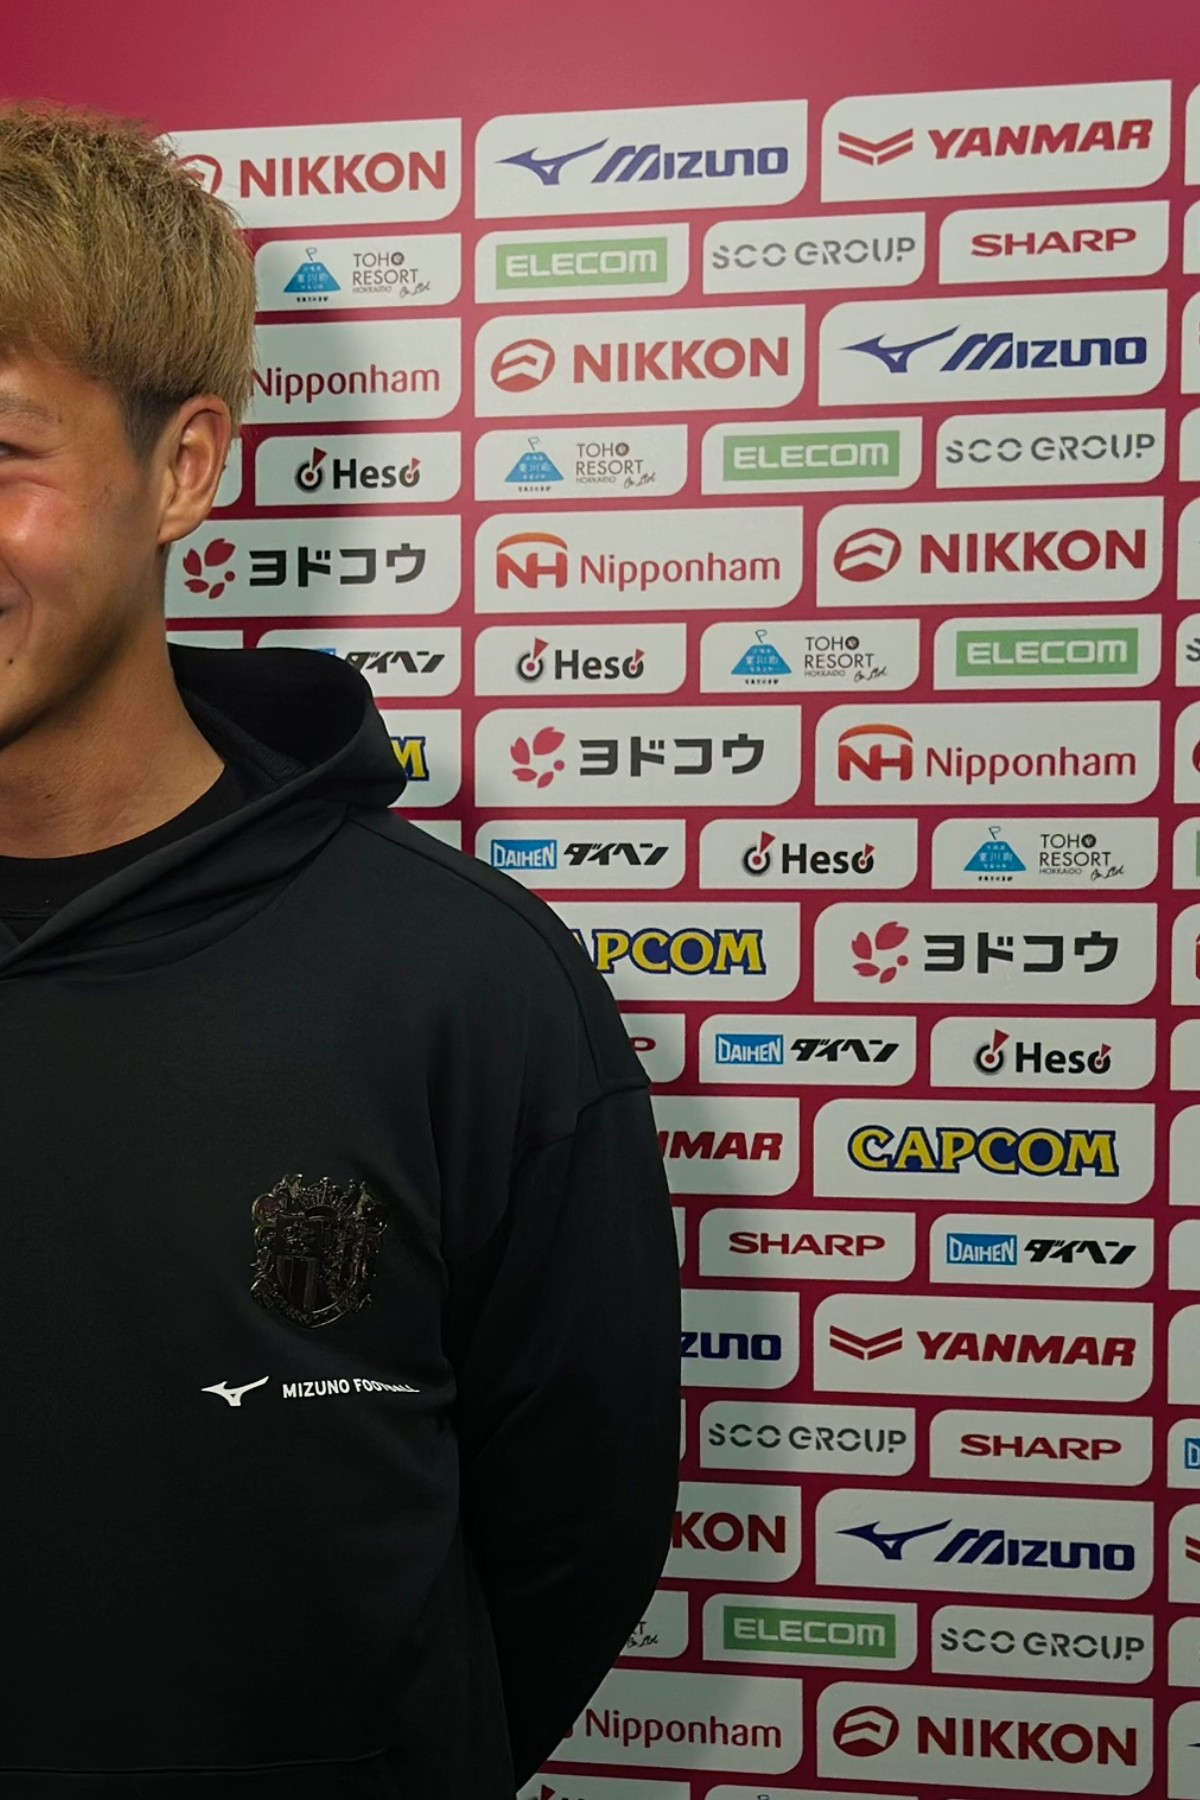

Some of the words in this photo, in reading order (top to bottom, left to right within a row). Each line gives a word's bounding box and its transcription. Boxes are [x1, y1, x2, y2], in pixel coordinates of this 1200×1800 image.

[928, 119, 1153, 160] YANMAR
[240, 150, 446, 198] NIKKON
[591, 144, 788, 184] MIZUNO
[712, 243, 786, 269] SCO
[795, 237, 916, 266] GROUP
[971, 228, 1137, 257] SHARP
[353, 251, 405, 268] TOHO
[506, 249, 657, 278] ELECOM
[353, 268, 418, 286] RESORT
[574, 337, 788, 383] NIKKON
[939, 332, 1147, 372] MIZUNO
[251, 364, 440, 404] Nipponham
[576, 442, 630, 458] TOHO
[733, 442, 889, 470] ELECOM
[946, 437, 1023, 464] SCO
[1031, 433, 1155, 461] GROUP
[333, 457, 420, 490] Heso
[575, 459, 644, 475] RESORT
[249, 543, 426, 588] ヨドコウ
[920, 529, 1146, 574] NIKKON
[581, 552, 780, 592] Nipponham
[805, 635, 860, 651] TOHO
[967, 639, 1128, 665] ELECOM
[555, 649, 645, 680] Heso
[804, 653, 875, 669] RESORT
[579, 733, 764, 777] ヨドコウ
[926, 746, 1136, 785] Nipponham
[493, 842, 555, 867] DAIHEN
[563, 842, 669, 866] ダイヘン
[1040, 833, 1097, 849] TOHO
[782, 843, 875, 875] Heso
[1039, 851, 1111, 867] RESORT
[570, 928, 766, 975] PCOM
[923, 931, 1118, 974] ヨドコウ
[718, 1037, 781, 1062] DAIHEN
[790, 1038, 899, 1062] ダイヘン
[1015, 1042, 1112, 1074] Heso
[847, 1125, 1119, 1177] CAPCOM
[729, 1232, 885, 1257] SHARP
[949, 1236, 1014, 1262] DAIHEN
[1024, 1239, 1137, 1265] ダイヘン
[916, 1331, 1136, 1367] YANMAR
[282, 1378, 351, 1398] MIZUNO
[708, 1423, 781, 1448] SCO
[788, 1426, 907, 1454] GROUP
[960, 1434, 1122, 1461] SHARP
[672, 1511, 786, 1553] KON
[933, 1528, 1135, 1571] MIZUNO
[734, 1618, 886, 1647] ELECOM
[940, 1627, 1016, 1654] SCO
[1023, 1631, 1145, 1661] GROUP
[586, 1709, 781, 1748] Nipponham
[917, 1716, 1137, 1766] NIKKON
